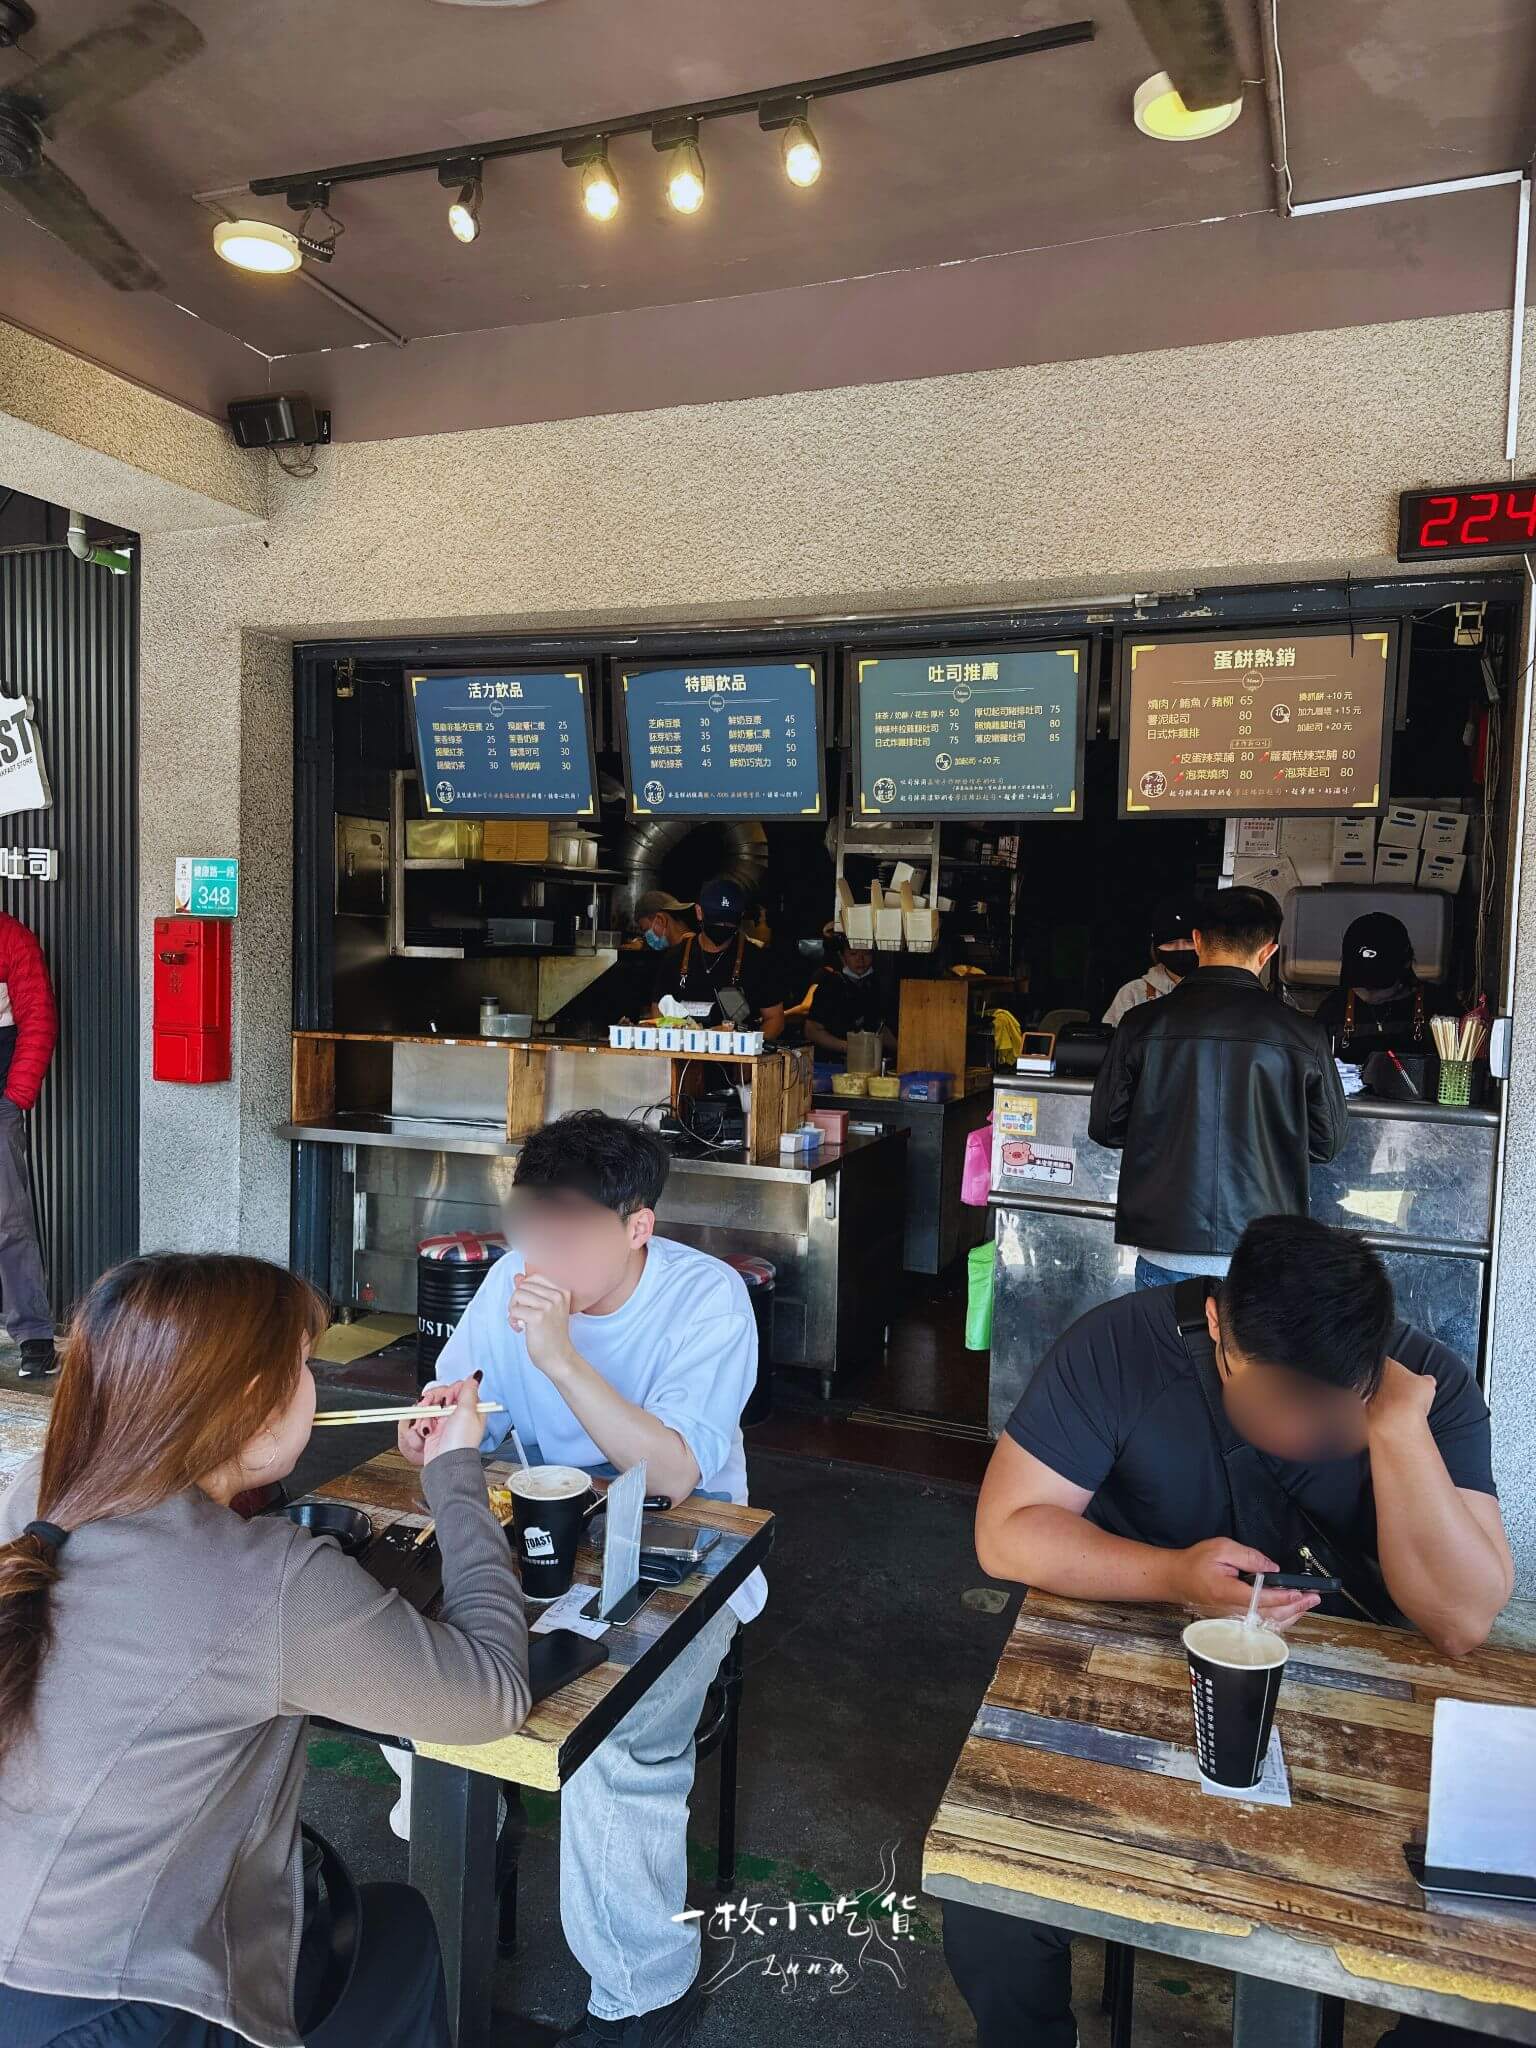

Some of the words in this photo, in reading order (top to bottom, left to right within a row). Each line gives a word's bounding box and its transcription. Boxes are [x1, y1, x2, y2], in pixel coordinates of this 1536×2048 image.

[1213, 647, 1296, 670] 蛋餅熱銷
[928, 662, 999, 683] 吐司推薦
[685, 674, 747, 692] 特調飲品
[468, 682, 524, 699] 活力飲品
[1326, 691, 1342, 701] +10
[1344, 691, 1352, 700] 元
[1147, 699, 1169, 710] 燒肉
[1179, 697, 1201, 709] 鮪魚
[1240, 696, 1253, 705] 65
[949, 708, 960, 717] 50
[1050, 705, 1061, 714] 75
[1353, 705, 1362, 715] 元
[785, 714, 795, 724] 45
[1238, 710, 1252, 720] 80
[485, 722, 495, 731] 25
[558, 721, 568, 730] 25
[700, 717, 710, 727] 30
[1049, 719, 1060, 728] 80
[1297, 722, 1323, 732] 加起司
[1343, 721, 1352, 731] 元
[950, 723, 960, 731] 75
[701, 732, 711, 740] 35
[785, 729, 796, 738] 45
[1147, 728, 1200, 740] 日式炸雞排
[1238, 725, 1252, 735] 80
[0, 709, 33, 768] ST
[486, 735, 496, 744] 25
[560, 733, 569, 742] 30
[950, 735, 960, 744] 75
[1049, 733, 1060, 742] 85
[487, 747, 497, 756] 25
[560, 747, 570, 756] 30
[701, 744, 711, 753] 45
[786, 743, 797, 752] 50
[1240, 751, 1254, 762] 80
[1342, 750, 1355, 760] 80
[702, 759, 712, 767] 45
[786, 759, 797, 767] 50
[993, 756, 1000, 765] 元
[489, 761, 499, 770] 30
[561, 761, 571, 771] 30
[1185, 769, 1229, 781] 泡菜燒肉
[1239, 770, 1253, 780] 80
[1285, 767, 1330, 778] 泡菜起司
[1340, 767, 1354, 777] 80
[198, 885, 230, 906] 348
[525, 1535, 552, 1550] TOAST
